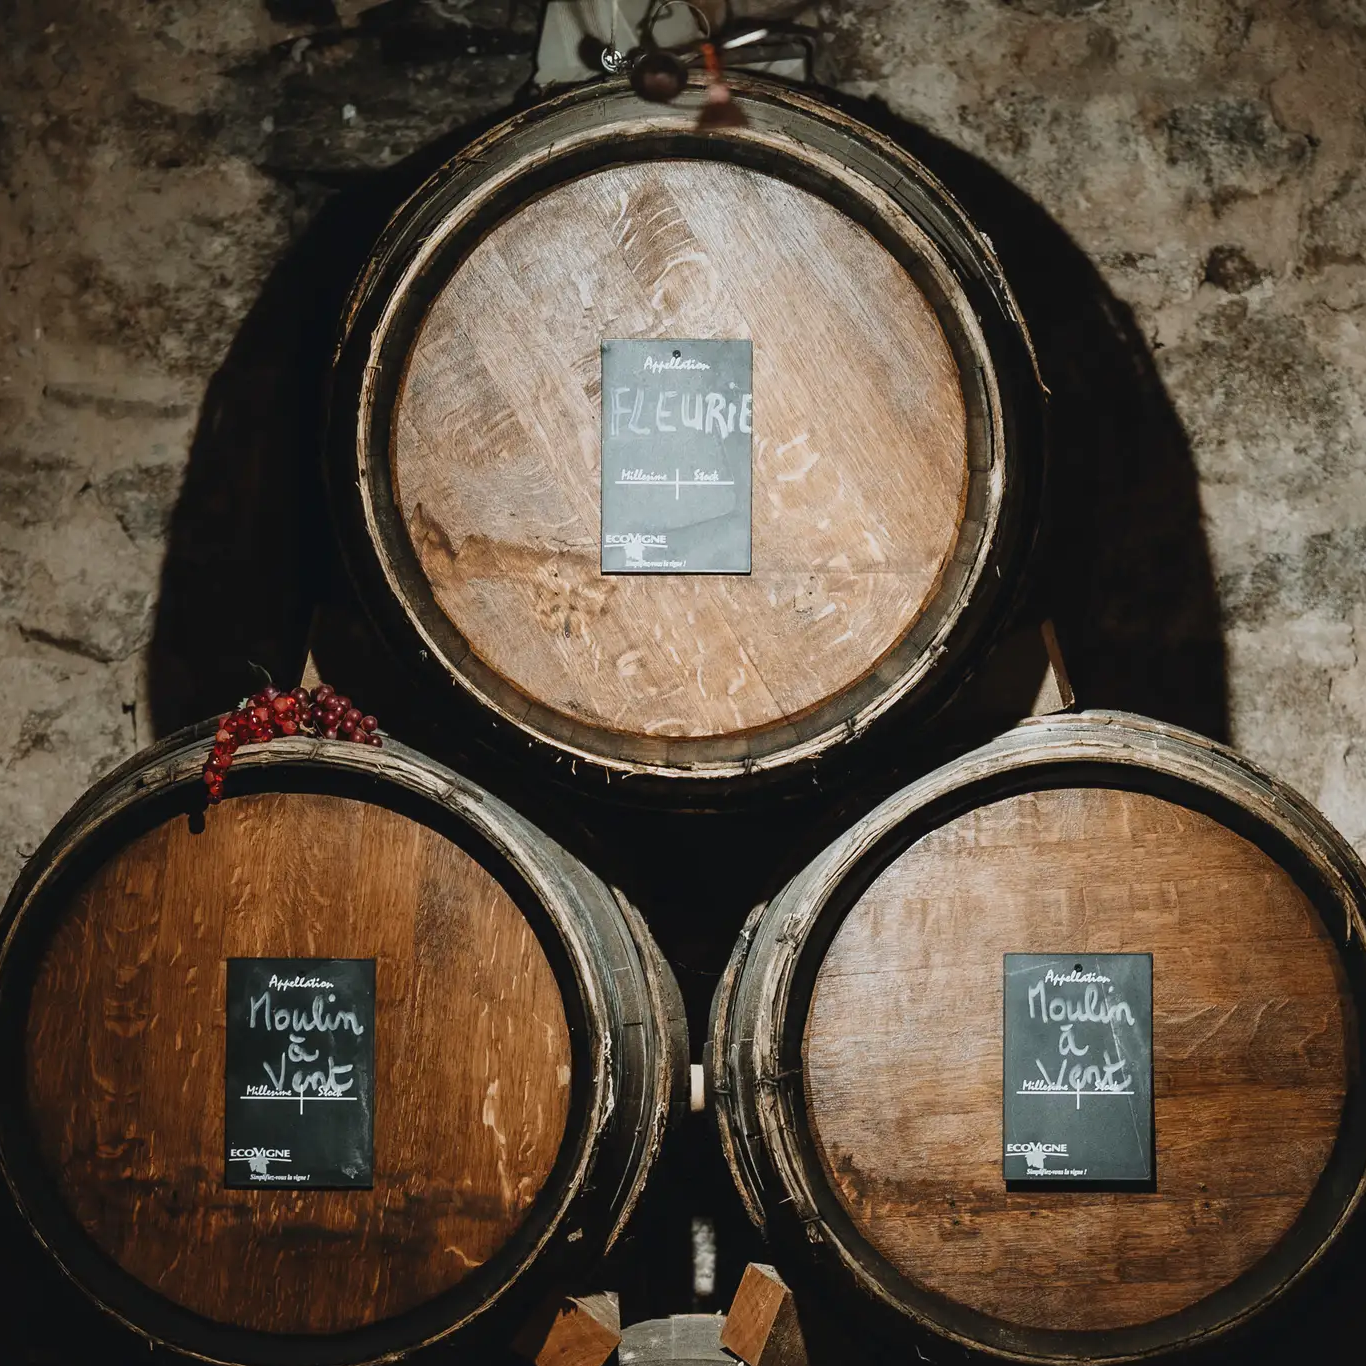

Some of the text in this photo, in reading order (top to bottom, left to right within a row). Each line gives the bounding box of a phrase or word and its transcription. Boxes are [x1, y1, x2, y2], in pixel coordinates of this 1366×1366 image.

[644, 356, 711, 373] Appellation
[610, 382, 753, 439] FLEURIE
[694, 469, 720, 481] Stock
[268, 974, 334, 991] Appellation
[1045, 969, 1111, 987] Appellation
[1028, 980, 1135, 1026] Moulin
[249, 991, 364, 1035] Moulin
[263, 1052, 354, 1093] Vent
[1035, 1051, 1132, 1091] Vent
[230, 1147, 291, 1158] ECOVIGNE
[1007, 1142, 1067, 1152] ECOVIGNE
